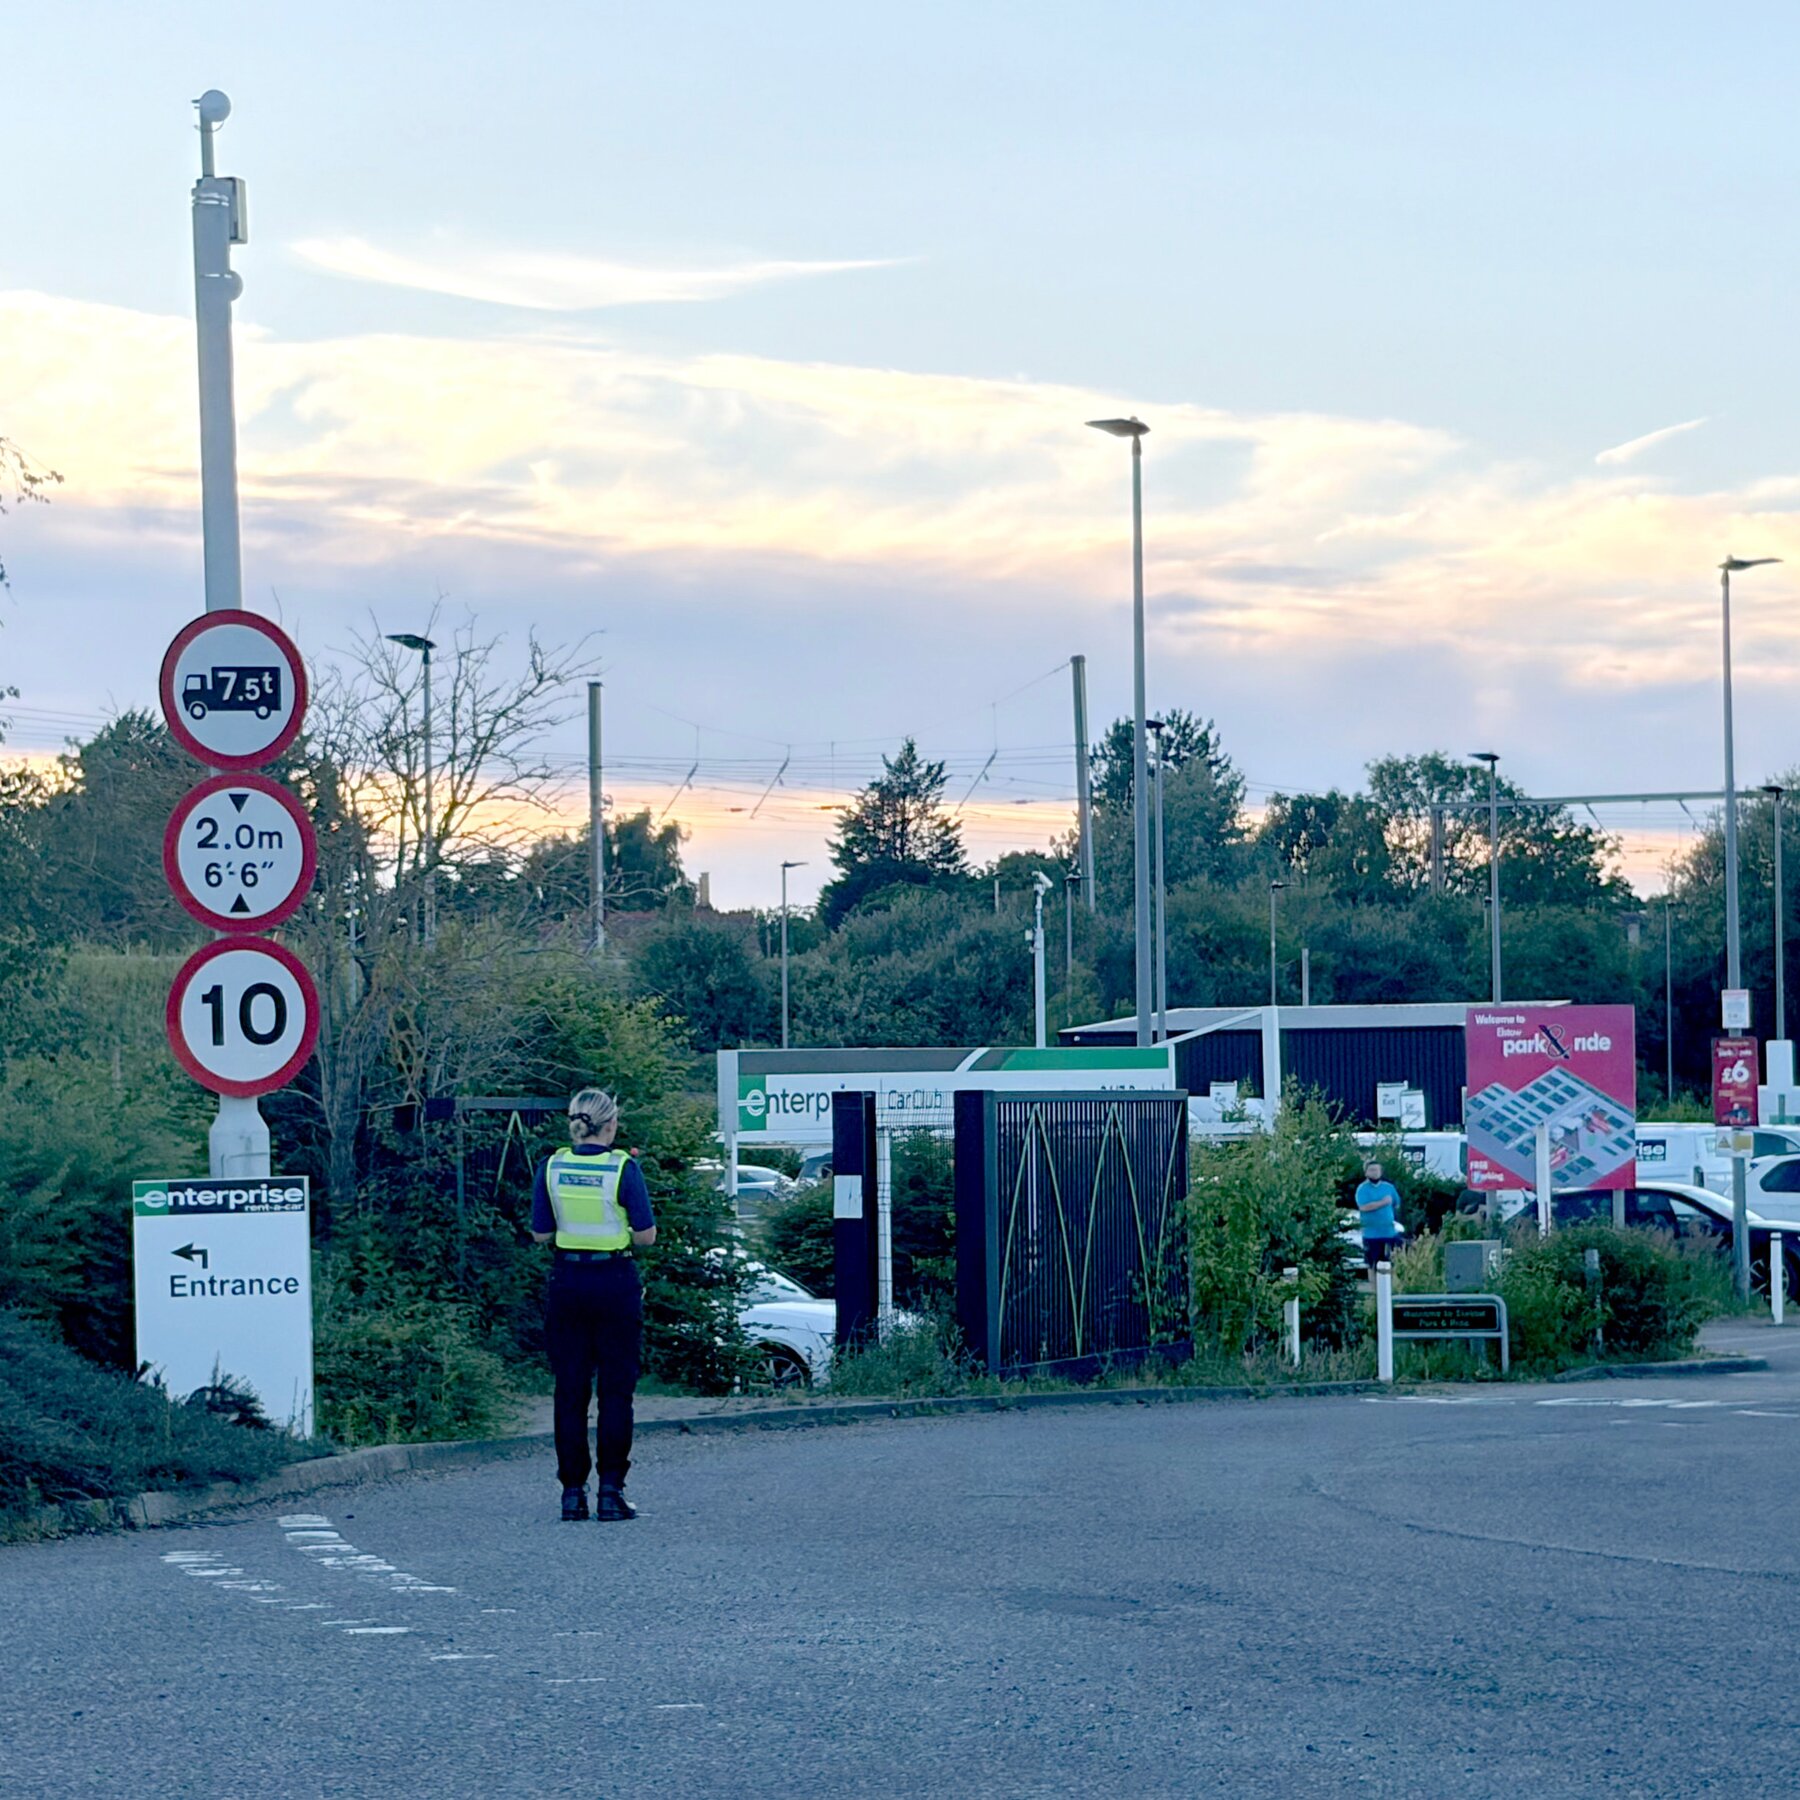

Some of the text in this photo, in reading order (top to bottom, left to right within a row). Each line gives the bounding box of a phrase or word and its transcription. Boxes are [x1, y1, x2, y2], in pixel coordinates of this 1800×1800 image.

[218, 671, 274, 702] 7.5t
[196, 817, 283, 850] 2.0m
[201, 982, 287, 1047] 10
[1475, 1014, 1526, 1024] Welcome to
[1502, 1033, 1546, 1057] park
[1574, 1031, 1611, 1051] ride
[1721, 1060, 1750, 1084] £6
[136, 1183, 304, 1210] enterprise
[244, 1203, 304, 1213] rent-a-car
[170, 1274, 299, 1297] Entrance
